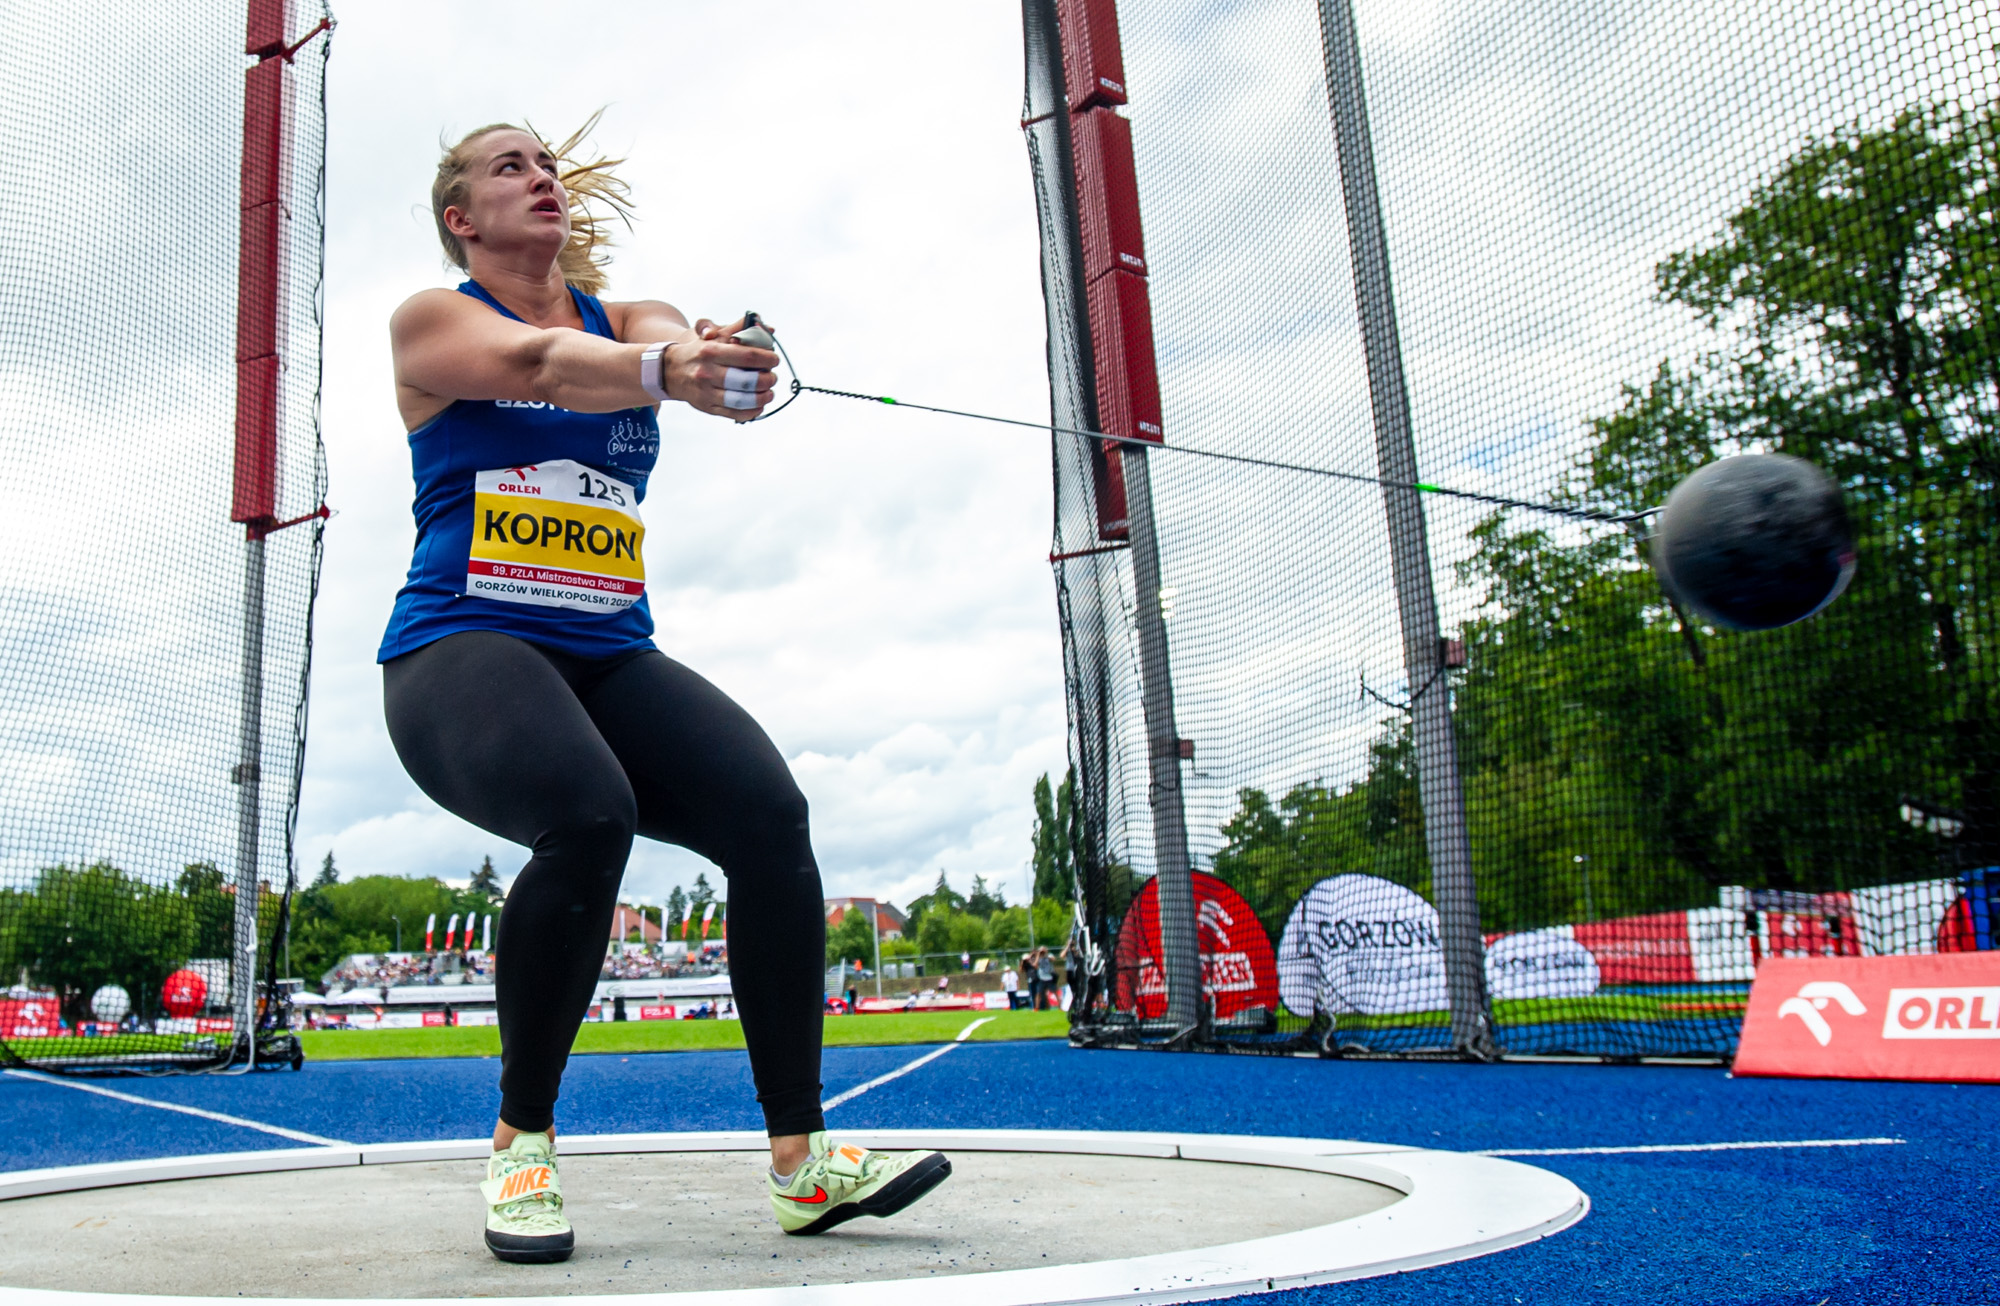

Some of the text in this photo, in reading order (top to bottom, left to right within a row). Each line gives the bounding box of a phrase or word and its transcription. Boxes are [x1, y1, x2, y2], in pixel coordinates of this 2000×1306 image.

[498, 483, 541, 495] ORLEN
[578, 472, 627, 507] 125
[484, 509, 637, 562] KOPRON
[475, 580, 528, 594] GORZÓW
[530, 587, 609, 606] WIELKOPOLSKI
[492, 565, 626, 592] 99. PZLA Mistrzostwa Polski
[643, 1007, 672, 1017] PZLA
[1897, 996, 2000, 1030] ORL
[499, 1166, 552, 1201] NIKE
